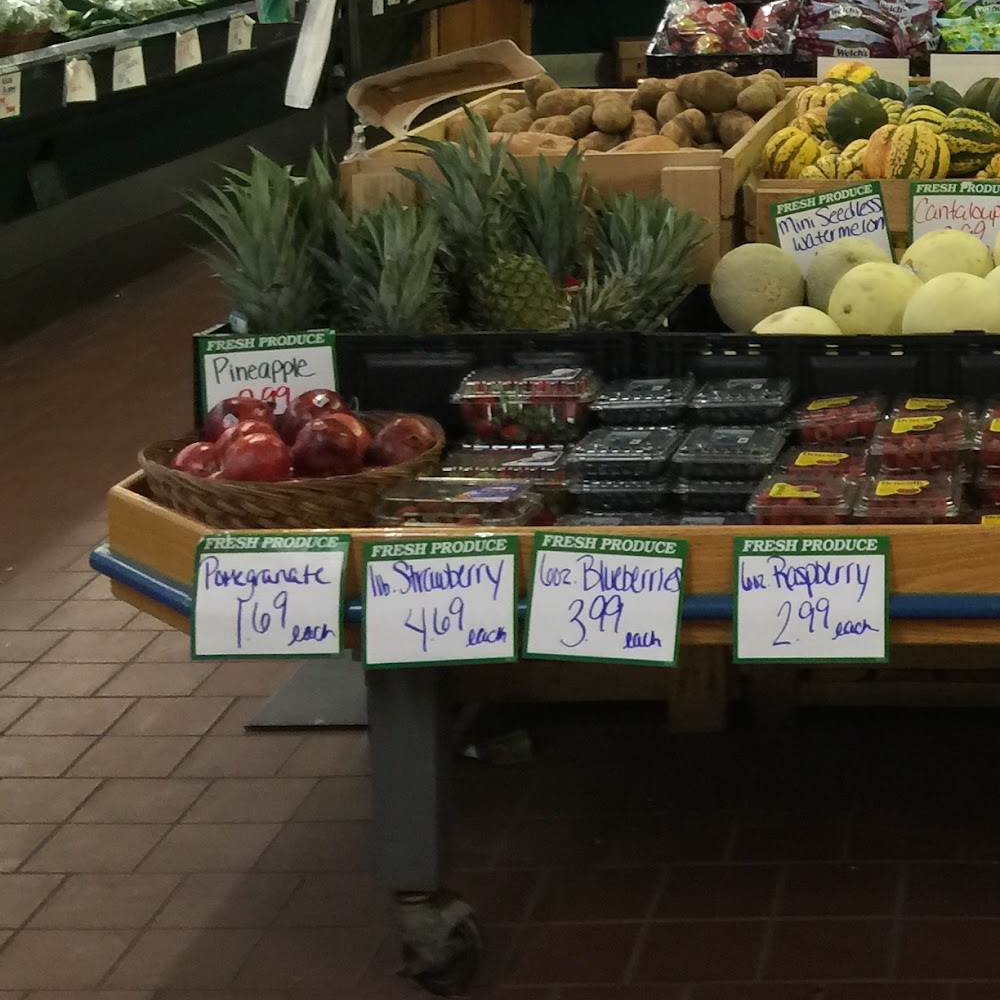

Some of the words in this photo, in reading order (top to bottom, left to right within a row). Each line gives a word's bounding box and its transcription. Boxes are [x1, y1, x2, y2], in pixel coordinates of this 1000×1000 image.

[836, 48, 869, 57] Welch's
[776, 197, 816, 215] FRESH
[819, 183, 873, 205] PRODUCE
[916, 183, 957, 194] FRESH
[815, 197, 883, 227] Seedless
[206, 337, 255, 352] FRESH
[258, 333, 326, 348] PRODUCE
[212, 356, 316, 384] Pineapple
[204, 536, 258, 550] FRESH
[261, 536, 339, 549] PRODUCE
[370, 543, 428, 558] FRESH
[430, 539, 508, 555] PRODUCE
[541, 534, 598, 550] FRESH
[599, 538, 677, 554] PRODUCE
[742, 539, 799, 552] FRESH
[800, 538, 878, 552] PRODUCE
[392, 559, 505, 600] Strawberry
[576, 554, 683, 593] Blueberries
[766, 555, 870, 603] Raspberry
[288, 623, 336, 646] each
[466, 626, 507, 647] each
[623, 630, 662, 649] each
[832, 619, 880, 641] each
